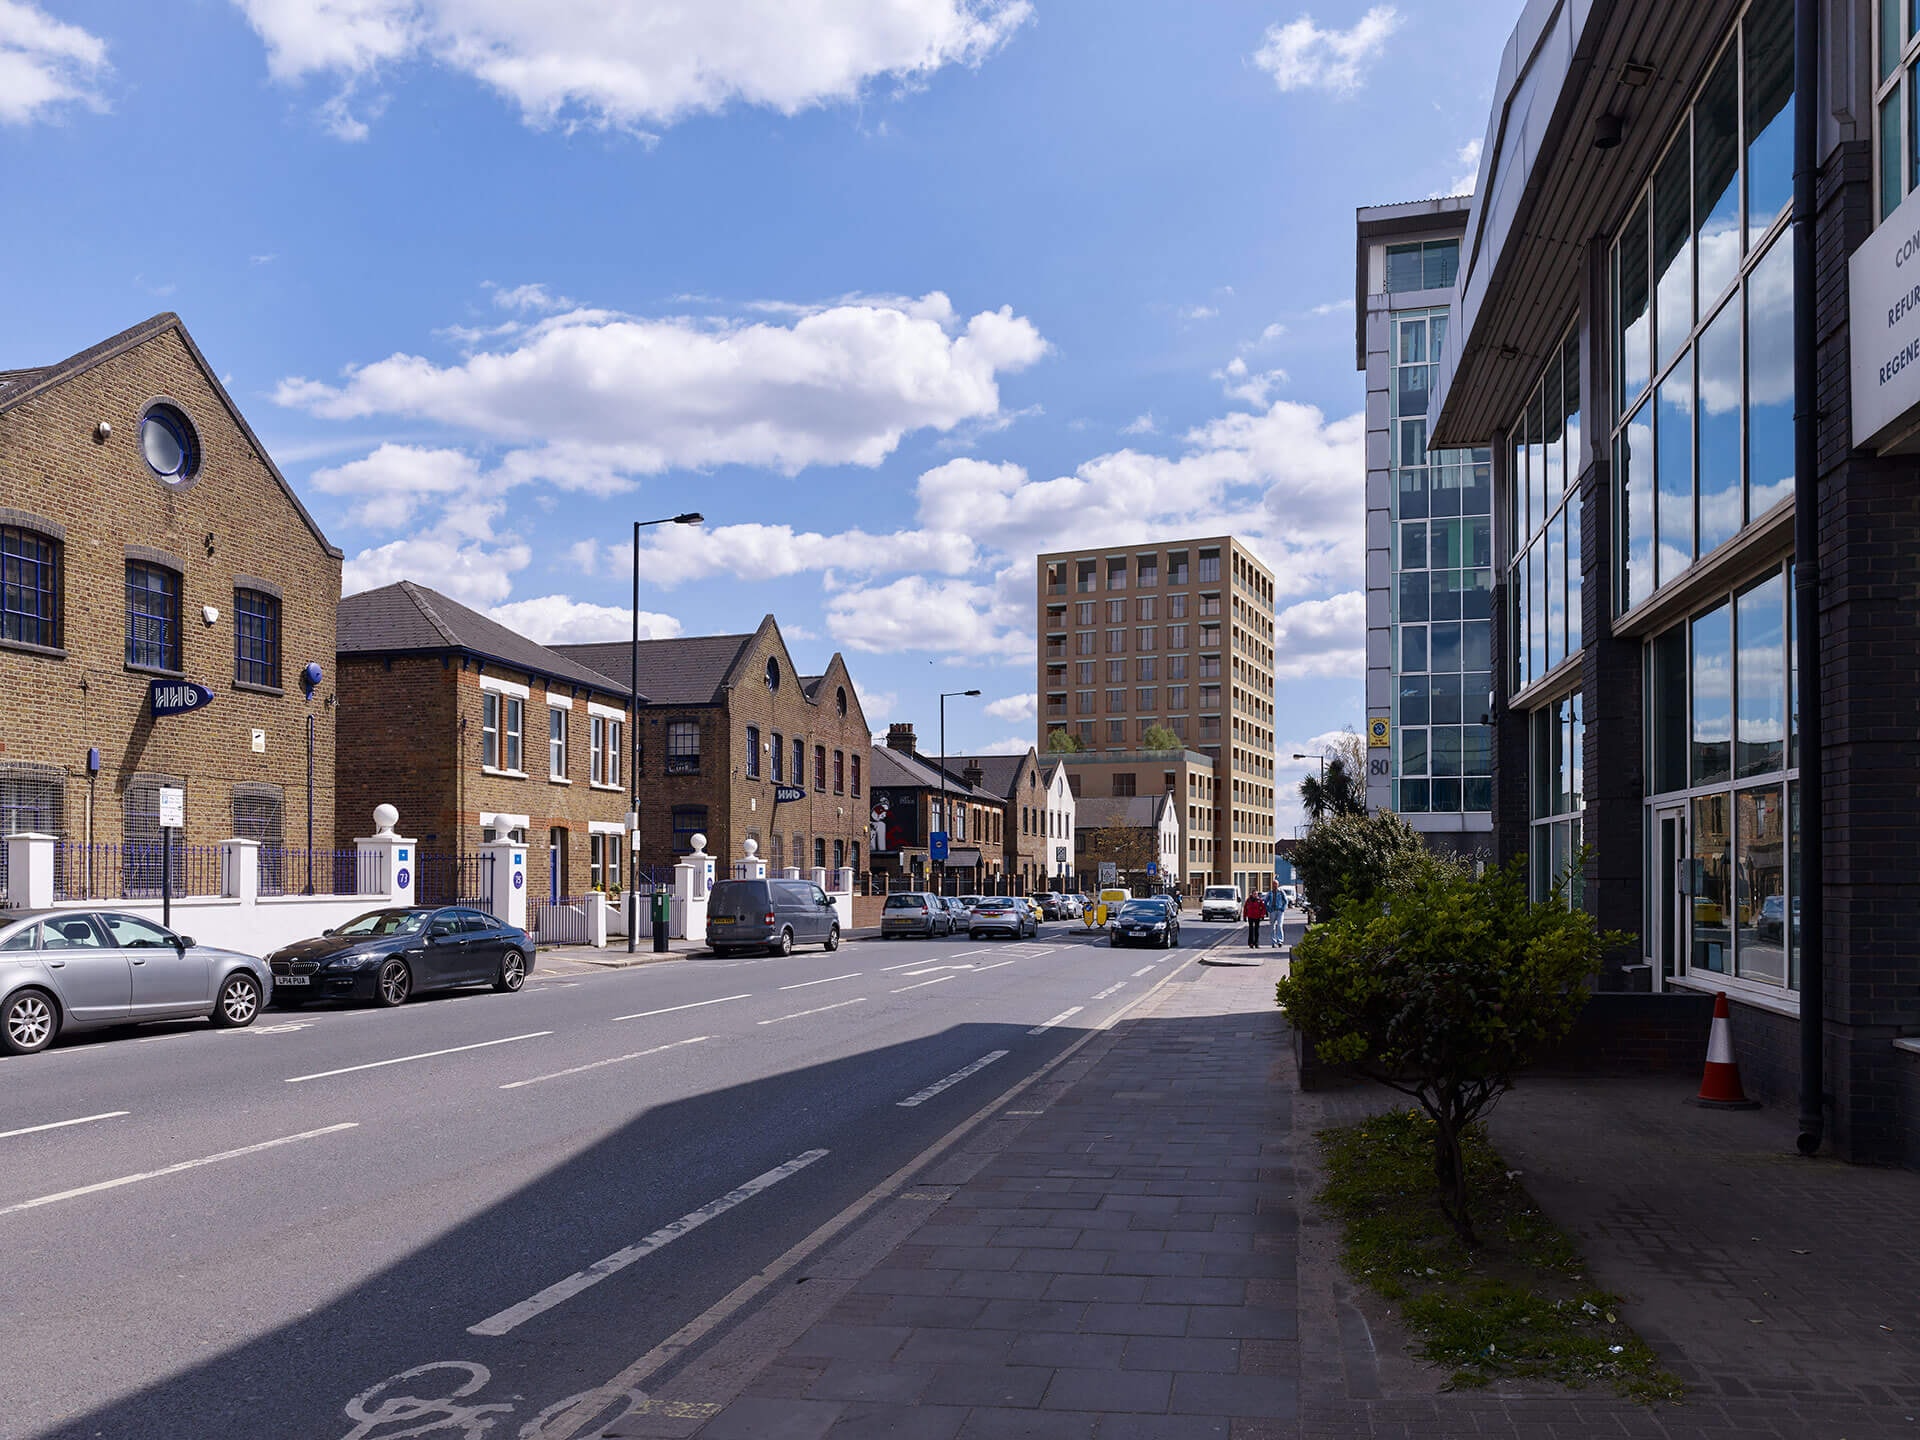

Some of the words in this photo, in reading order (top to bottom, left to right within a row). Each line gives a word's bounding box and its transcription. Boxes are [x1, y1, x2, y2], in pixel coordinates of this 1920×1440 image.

[1879, 338, 1920, 386] REGENE
[1371, 760, 1388, 775] 80
[400, 873, 408, 883] 73
